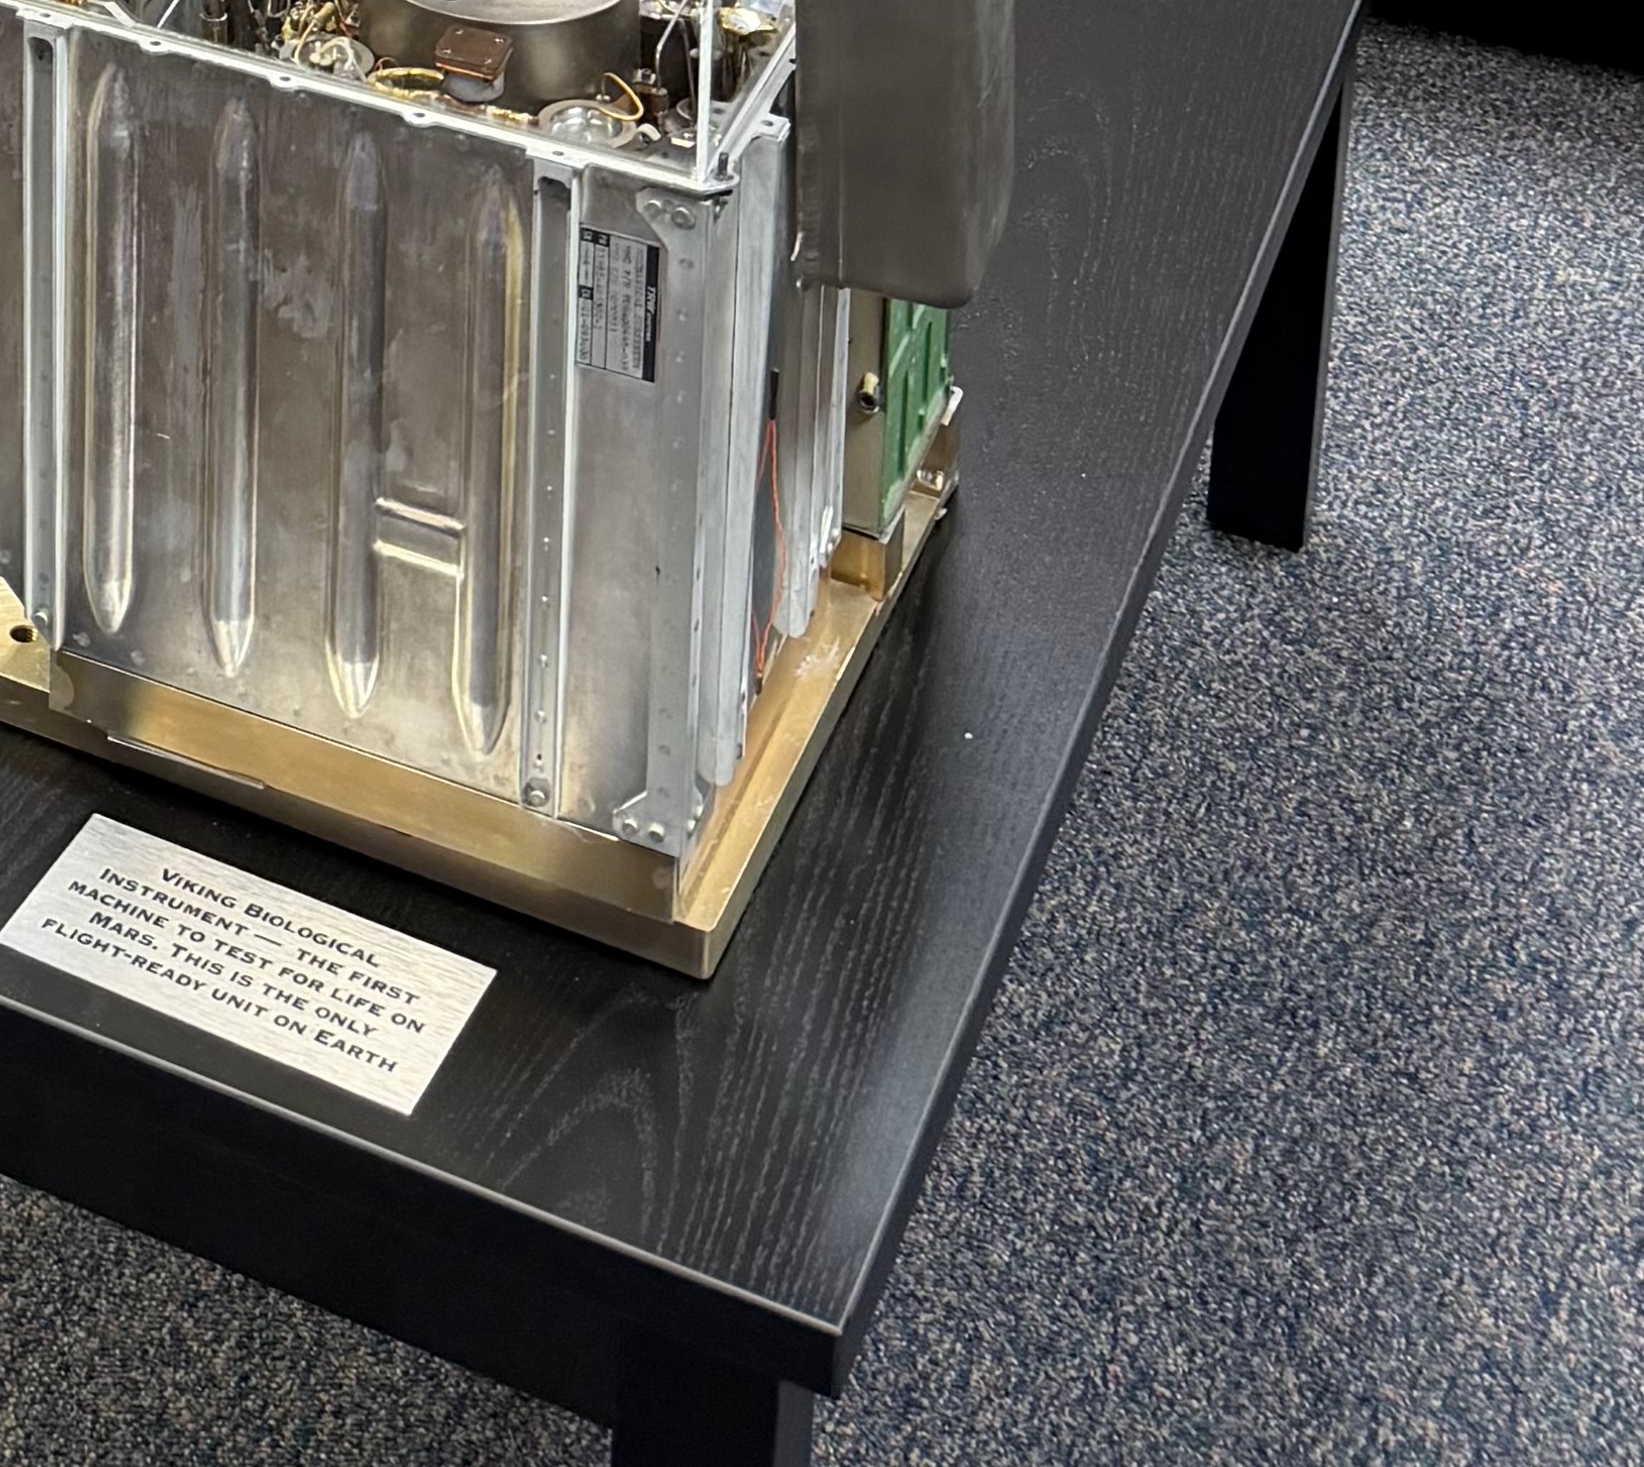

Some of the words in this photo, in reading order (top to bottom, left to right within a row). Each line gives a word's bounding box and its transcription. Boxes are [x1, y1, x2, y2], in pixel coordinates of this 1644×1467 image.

[646, 285, 658, 315] TRW
[68, 881, 170, 929] MACHINE
[177, 924, 206, 943] TO
[213, 938, 274, 969] TEST
[277, 967, 325, 993] FOR
[330, 987, 386, 1017] LIFE
[390, 1012, 426, 1034] ON
[88, 911, 159, 951] MARS.
[171, 943, 225, 976] THIS
[229, 971, 254, 988] IS
[262, 983, 310, 1011] THE
[315, 1006, 379, 1037] ONLY
[99, 868, 249, 936] INSTRUMENT
[297, 948, 345, 976] THE
[348, 970, 421, 1006] FIRST
[162, 868, 238, 910] VIKING
[244, 903, 380, 968] BIOLOGICAL
[41, 918, 207, 992] FLIGHT-READY
[211, 988, 268, 1018] UNIT
[273, 1014, 308, 1035] ON
[313, 1029, 399, 1073] EARTH
